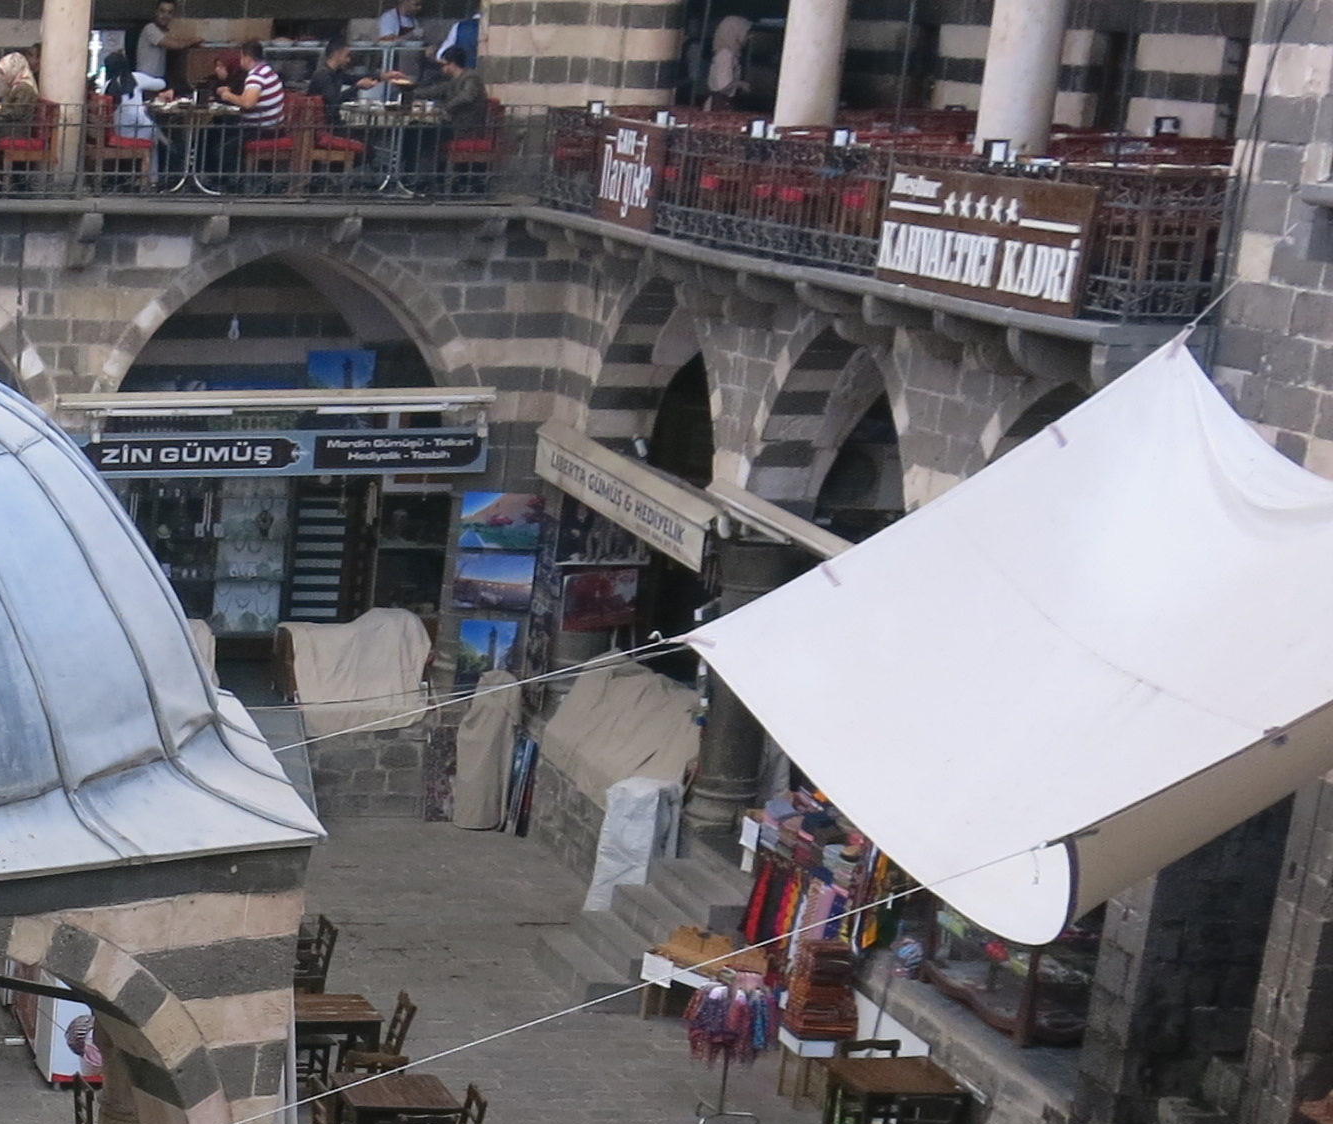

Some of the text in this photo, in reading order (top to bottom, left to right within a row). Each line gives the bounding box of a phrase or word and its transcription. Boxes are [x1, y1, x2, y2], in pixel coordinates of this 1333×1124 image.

[877, 220, 1081, 304] KAHVALTICI KADRİ
[159, 442, 273, 465] GÜMÜŞ
